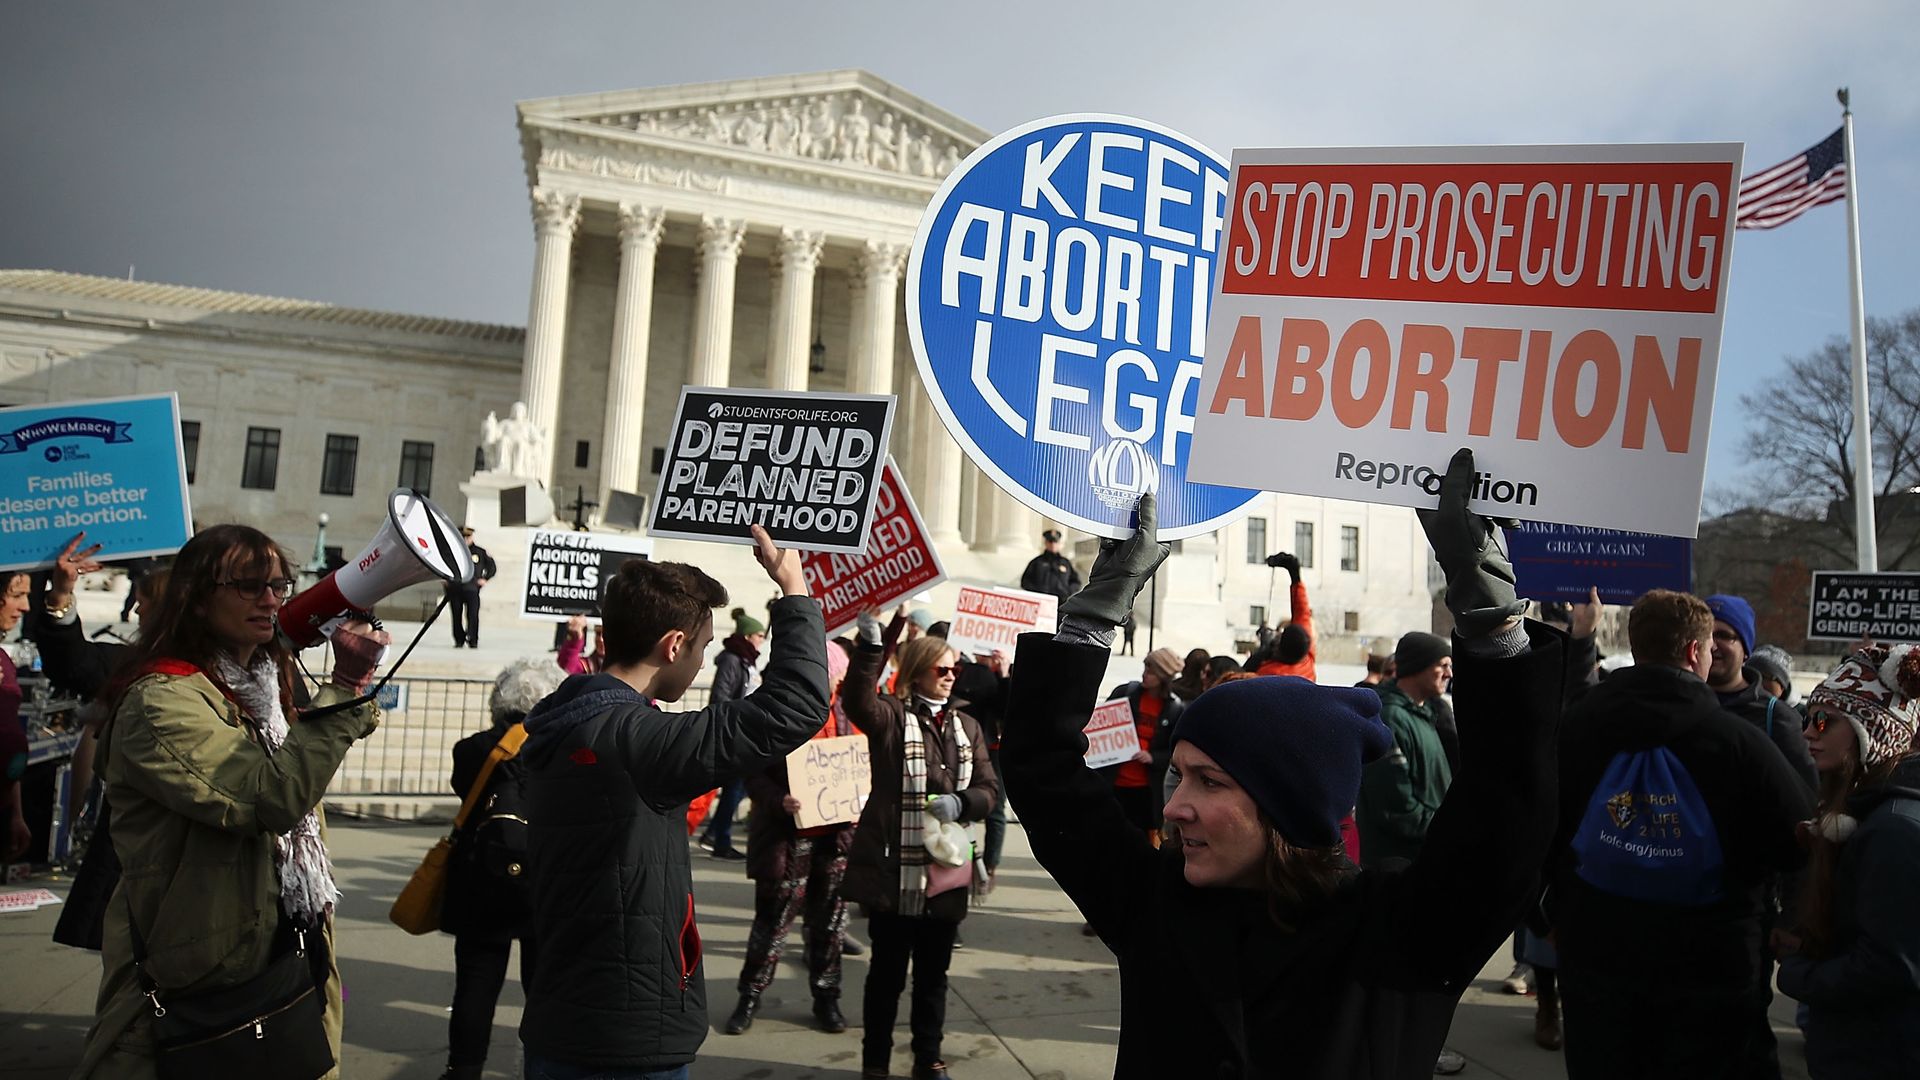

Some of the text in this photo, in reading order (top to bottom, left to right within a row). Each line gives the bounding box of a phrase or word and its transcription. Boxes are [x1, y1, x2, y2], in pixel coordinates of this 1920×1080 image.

[1233, 180, 1720, 292] STOP PROSECUTING
[941, 201, 1210, 358] ABORTI
[970, 319, 1204, 467] LEGA
[1208, 315, 1703, 454] ABORTION
[723, 405, 859, 423] STUDENTSFORLIFE.ORG
[677, 419, 874, 469] DEFUND
[27, 471, 113, 493] Families
[668, 460, 865, 506] PLANNED
[1335, 452, 1538, 506] Reproation
[0, 487, 148, 515] deserve better
[661, 496, 859, 533] PARENTHOOD
[1, 505, 148, 533] than abortion.
[359, 547, 381, 571] PYLE
[533, 547, 601, 566] ABORTION
[802, 516, 912, 596] PLANNED
[1546, 541, 1646, 557] GREAT AGAIN!
[530, 561, 600, 588] KILLS
[529, 585, 598, 601] A PERSON!!
[1821, 587, 1920, 601] I AM THE
[1815, 600, 1920, 620] PRO-LIFE
[1816, 619, 1920, 636] GENERATION
[805, 742, 871, 770] Abortio
[1090, 728, 1137, 756] RTION
[1653, 813, 1679, 825] LIFE
